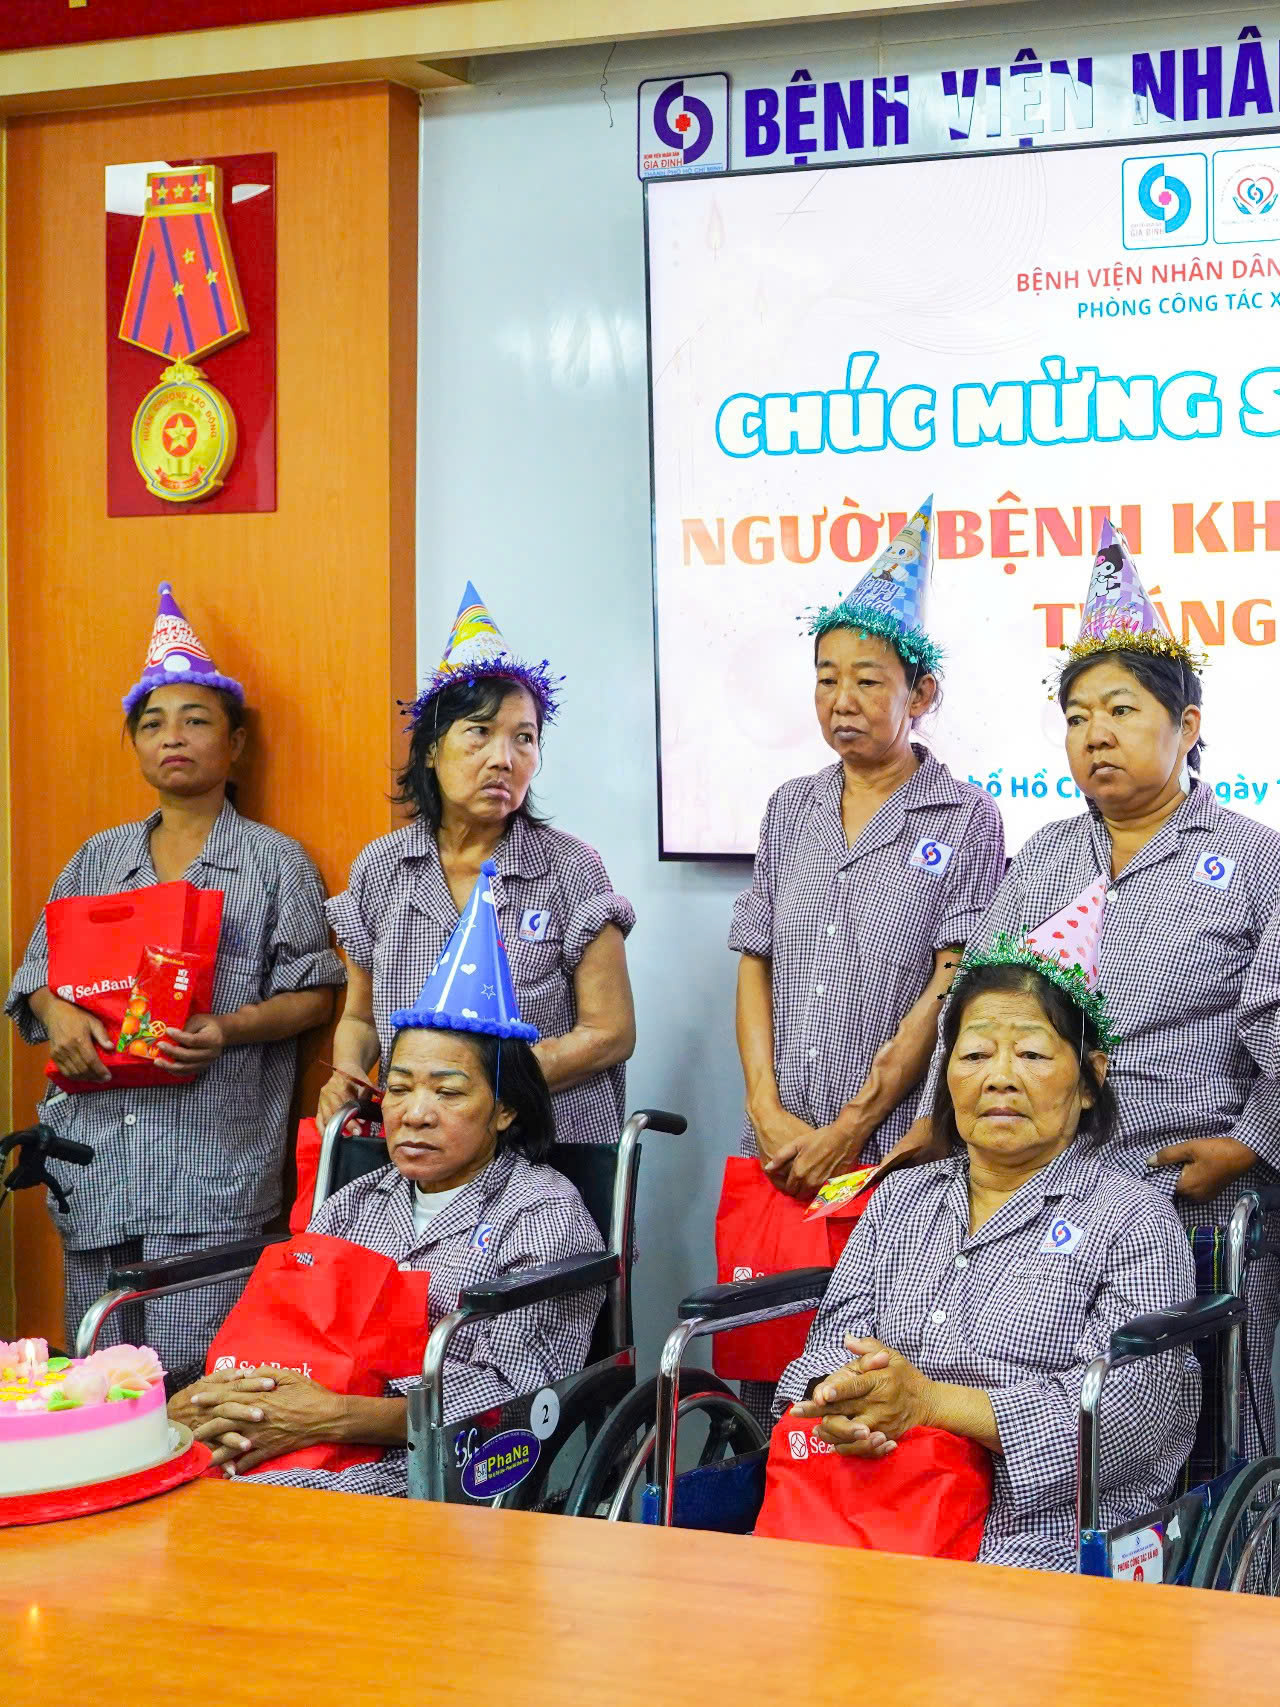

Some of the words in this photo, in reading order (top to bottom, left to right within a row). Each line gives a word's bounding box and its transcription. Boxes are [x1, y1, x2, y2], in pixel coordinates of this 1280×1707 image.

[744, 69, 909, 165] BỆNH
[941, 48, 1093, 147] VIỆN
[643, 160, 659, 170] GIA
[661, 158, 683, 169] ĐỊNH
[1017, 267, 1079, 296] BỆNH
[1087, 261, 1142, 292] VIỆN
[1152, 256, 1223, 284] NHÂN
[1078, 296, 1152, 319] PHÒNG
[1158, 292, 1218, 314] CÔNG
[1225, 288, 1263, 311] TÁC
[716, 351, 937, 458] CHÚC
[953, 355, 1223, 447] MỪNG
[937, 490, 1142, 575] BỆNH
[1032, 585, 1276, 650] TNG
[1011, 768, 1048, 798] Hồ
[1215, 773, 1269, 805] gày
[76, 975, 137, 999] SeABank
[541, 1404, 550, 1425] 2
[487, 1444, 529, 1473] PhaNa
